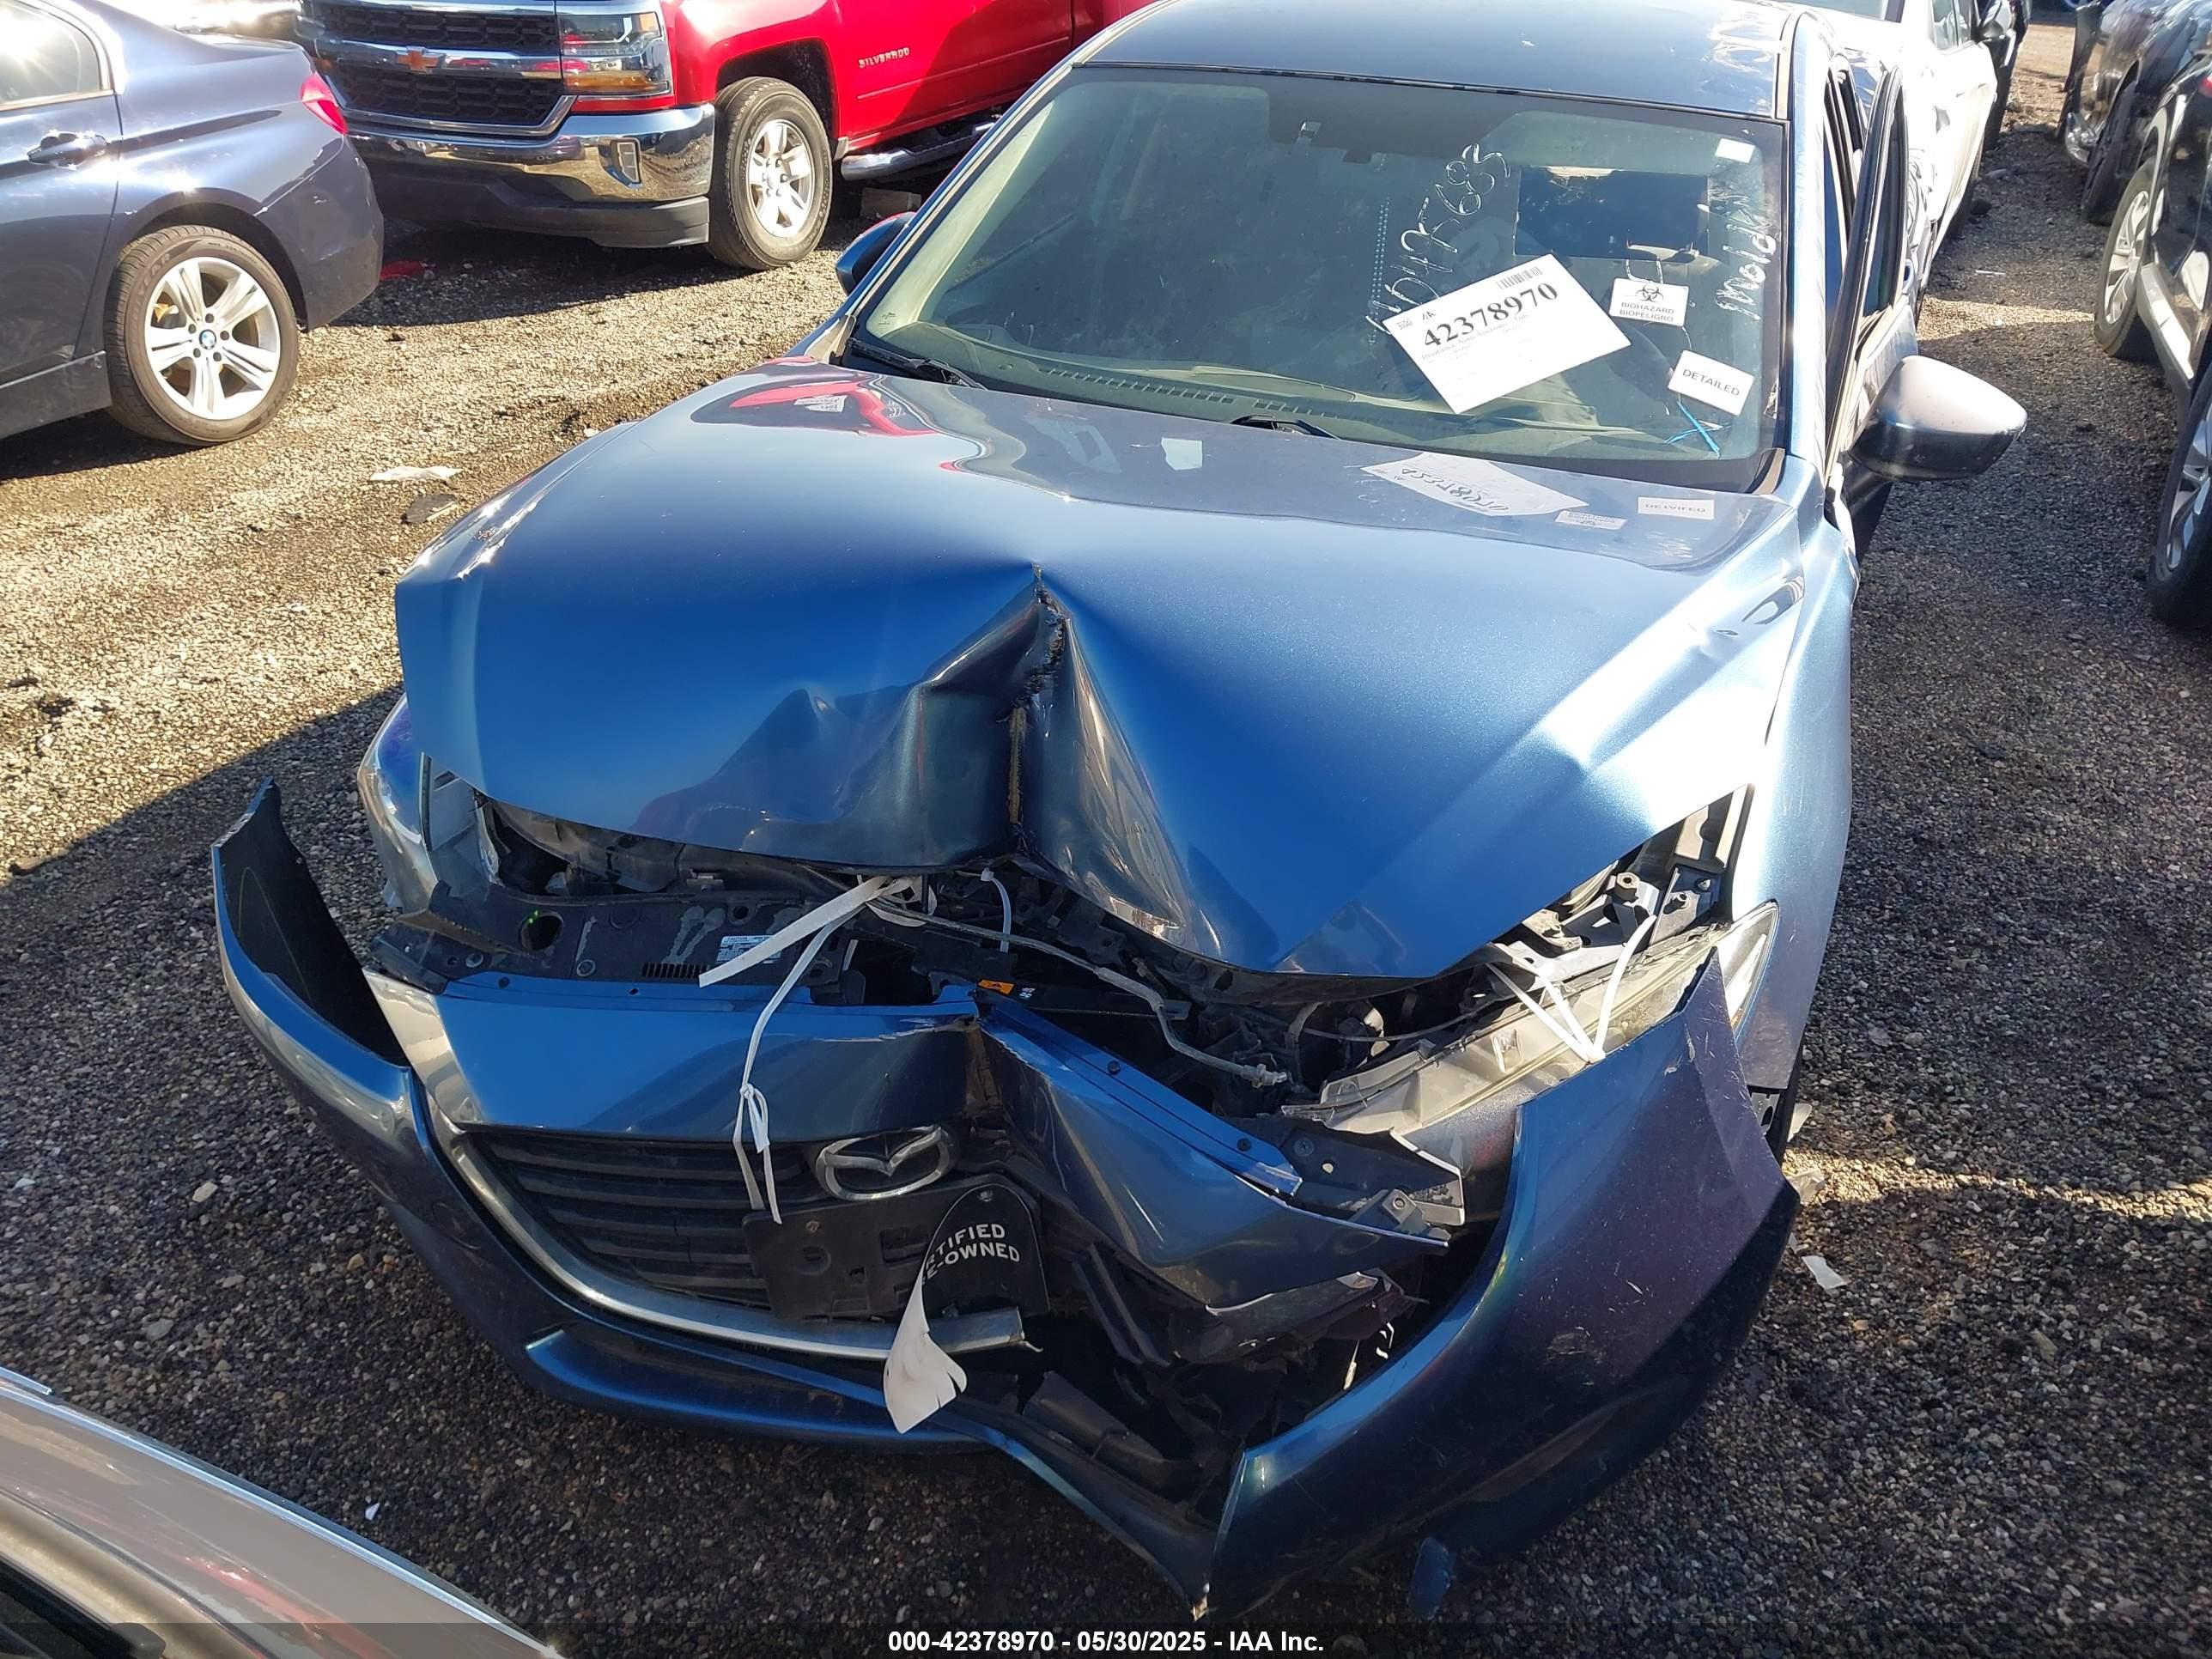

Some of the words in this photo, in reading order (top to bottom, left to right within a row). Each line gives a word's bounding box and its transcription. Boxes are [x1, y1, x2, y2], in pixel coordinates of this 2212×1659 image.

[859, 47, 910, 69] SILVERADO
[1424, 283, 1558, 346] 42378970
[1620, 309, 1674, 322] BIOPELIGRO
[1621, 301, 1674, 314] BIOHAZARD
[1682, 368, 1740, 396] DETAILED
